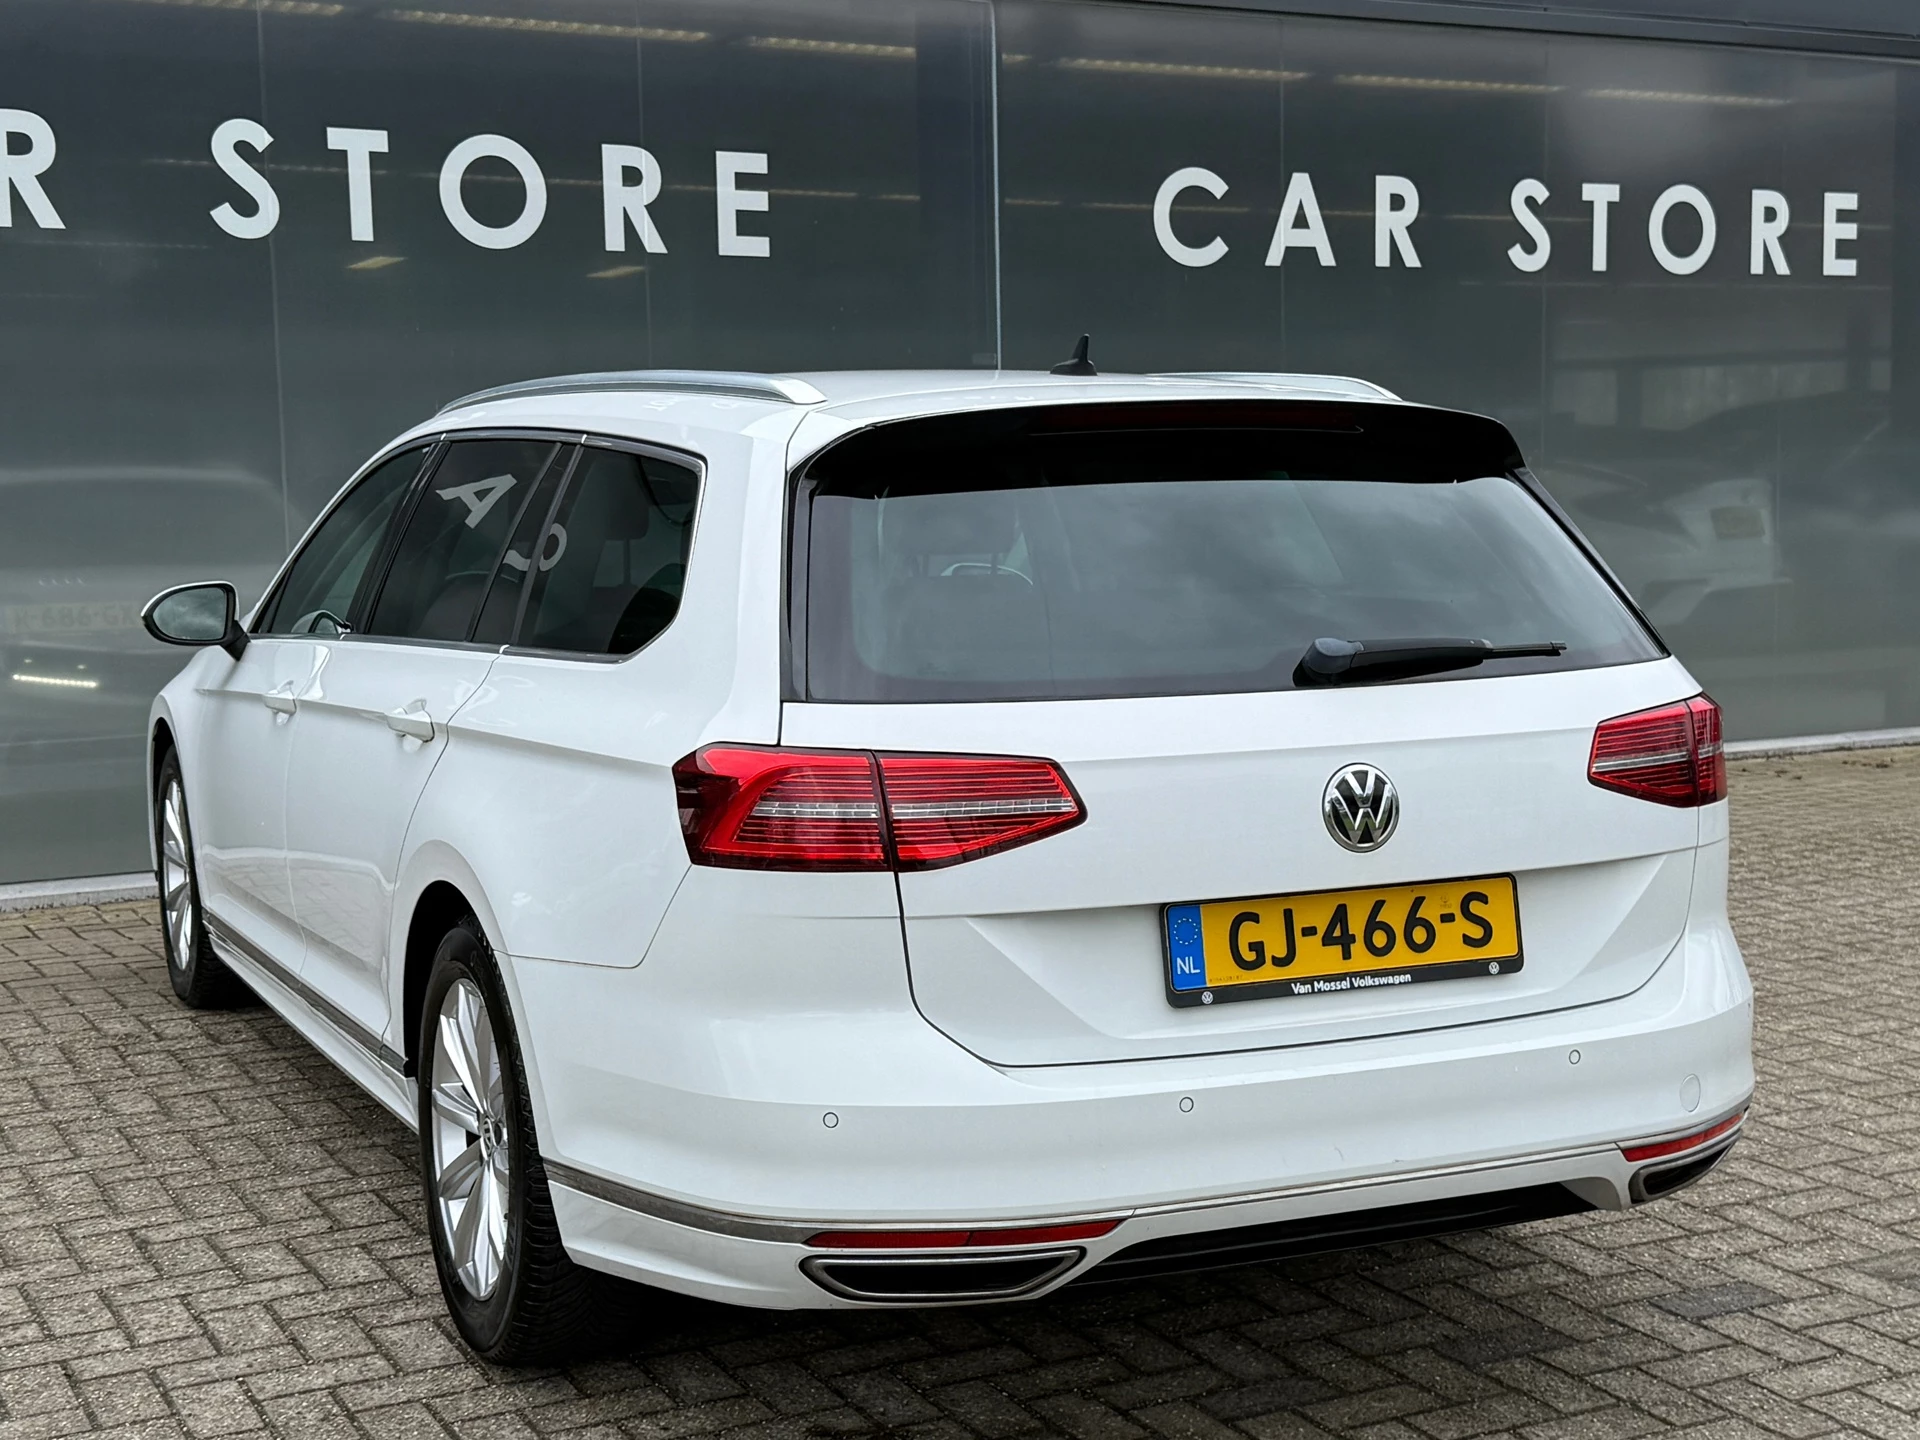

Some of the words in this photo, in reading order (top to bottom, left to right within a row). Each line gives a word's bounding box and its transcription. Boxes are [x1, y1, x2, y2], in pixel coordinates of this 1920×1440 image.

[210, 119, 770, 257] STORE
[1154, 166, 1421, 268] CAR
[1508, 178, 1858, 275] STORE
[1176, 956, 1201, 975] NL
[1229, 891, 1493, 971] GJ-466-S
[1291, 982, 1312, 995] Van
[1313, 977, 1350, 992] Mossel
[1352, 973, 1412, 988] Volkswagen
